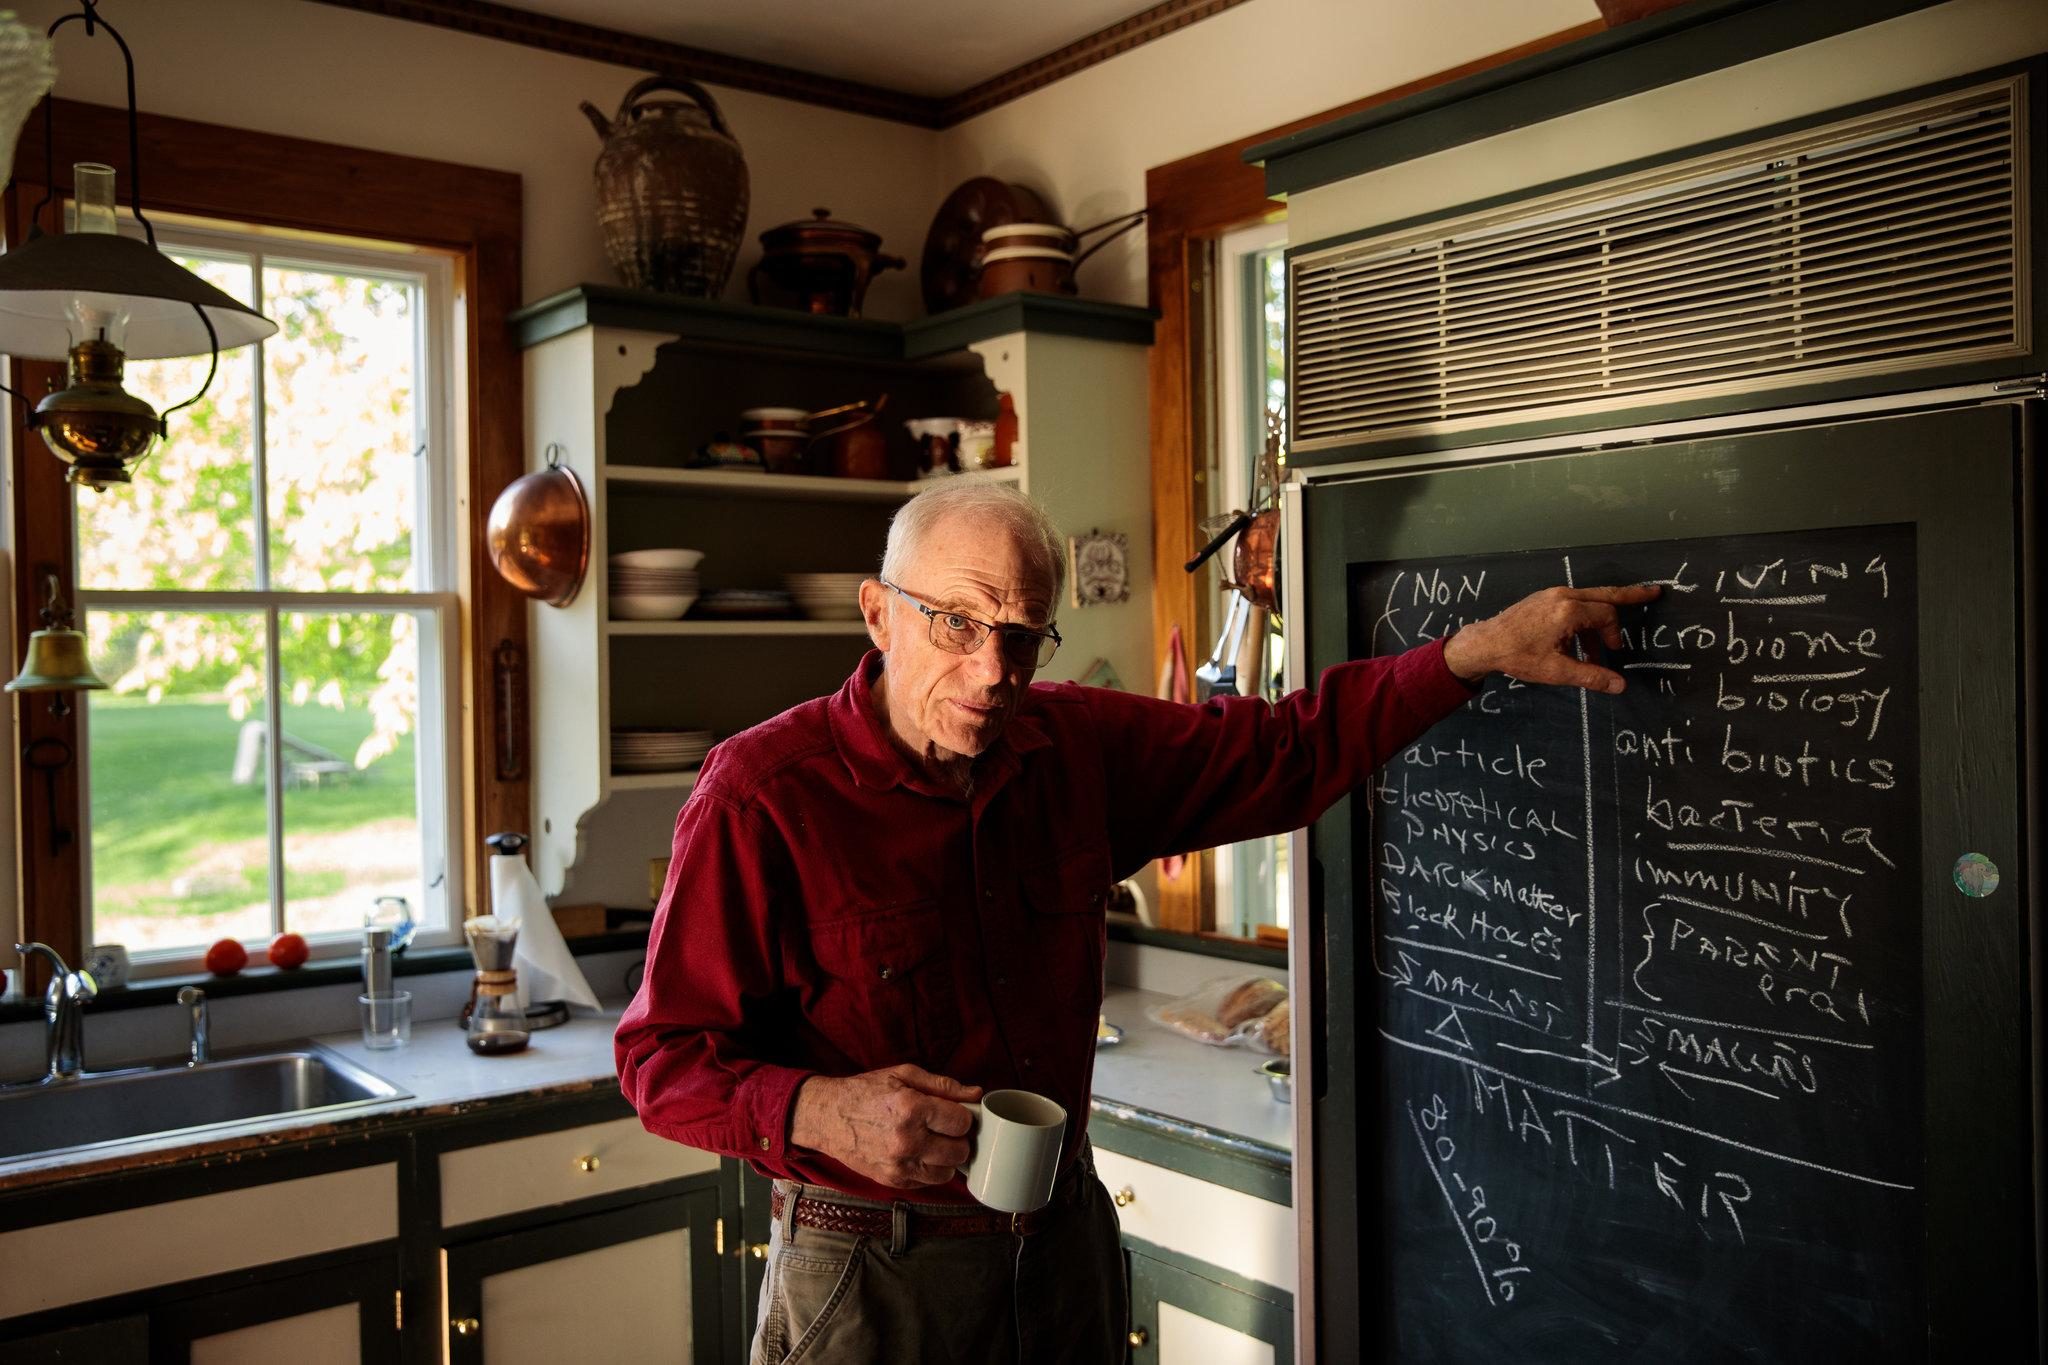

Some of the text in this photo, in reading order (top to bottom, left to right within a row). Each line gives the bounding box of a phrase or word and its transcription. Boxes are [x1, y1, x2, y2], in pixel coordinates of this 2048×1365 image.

[1716, 672, 1890, 741] biology
[1381, 738, 1548, 789] article
[1473, 1066, 1752, 1246] MATTER
